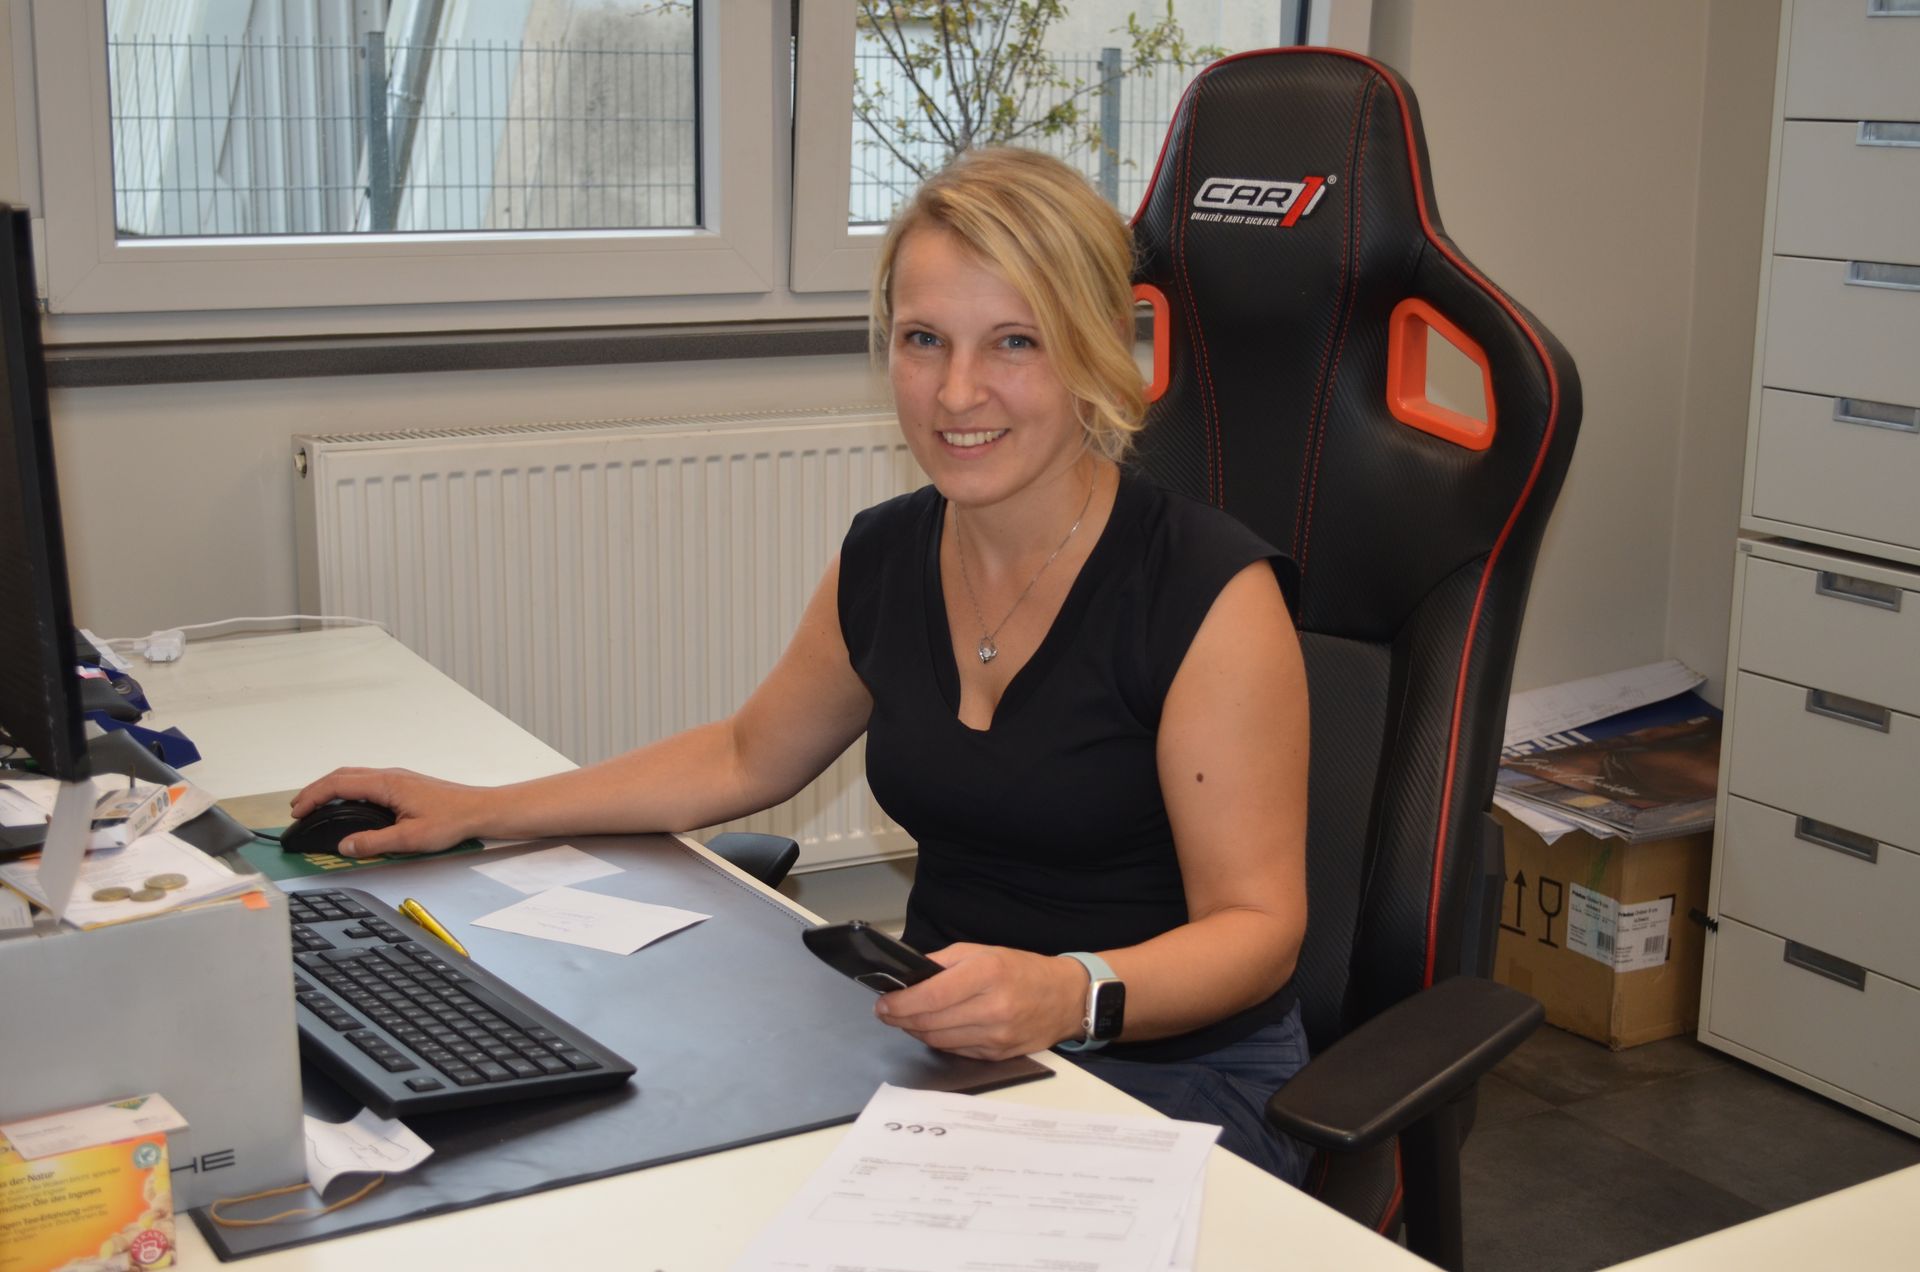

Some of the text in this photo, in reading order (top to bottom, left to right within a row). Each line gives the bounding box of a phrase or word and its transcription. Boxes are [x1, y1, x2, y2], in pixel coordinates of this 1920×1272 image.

[1191, 212, 1279, 227] QUALITÄT ZAHLT SICH AUS
[27, 1170, 56, 1183] Natur
